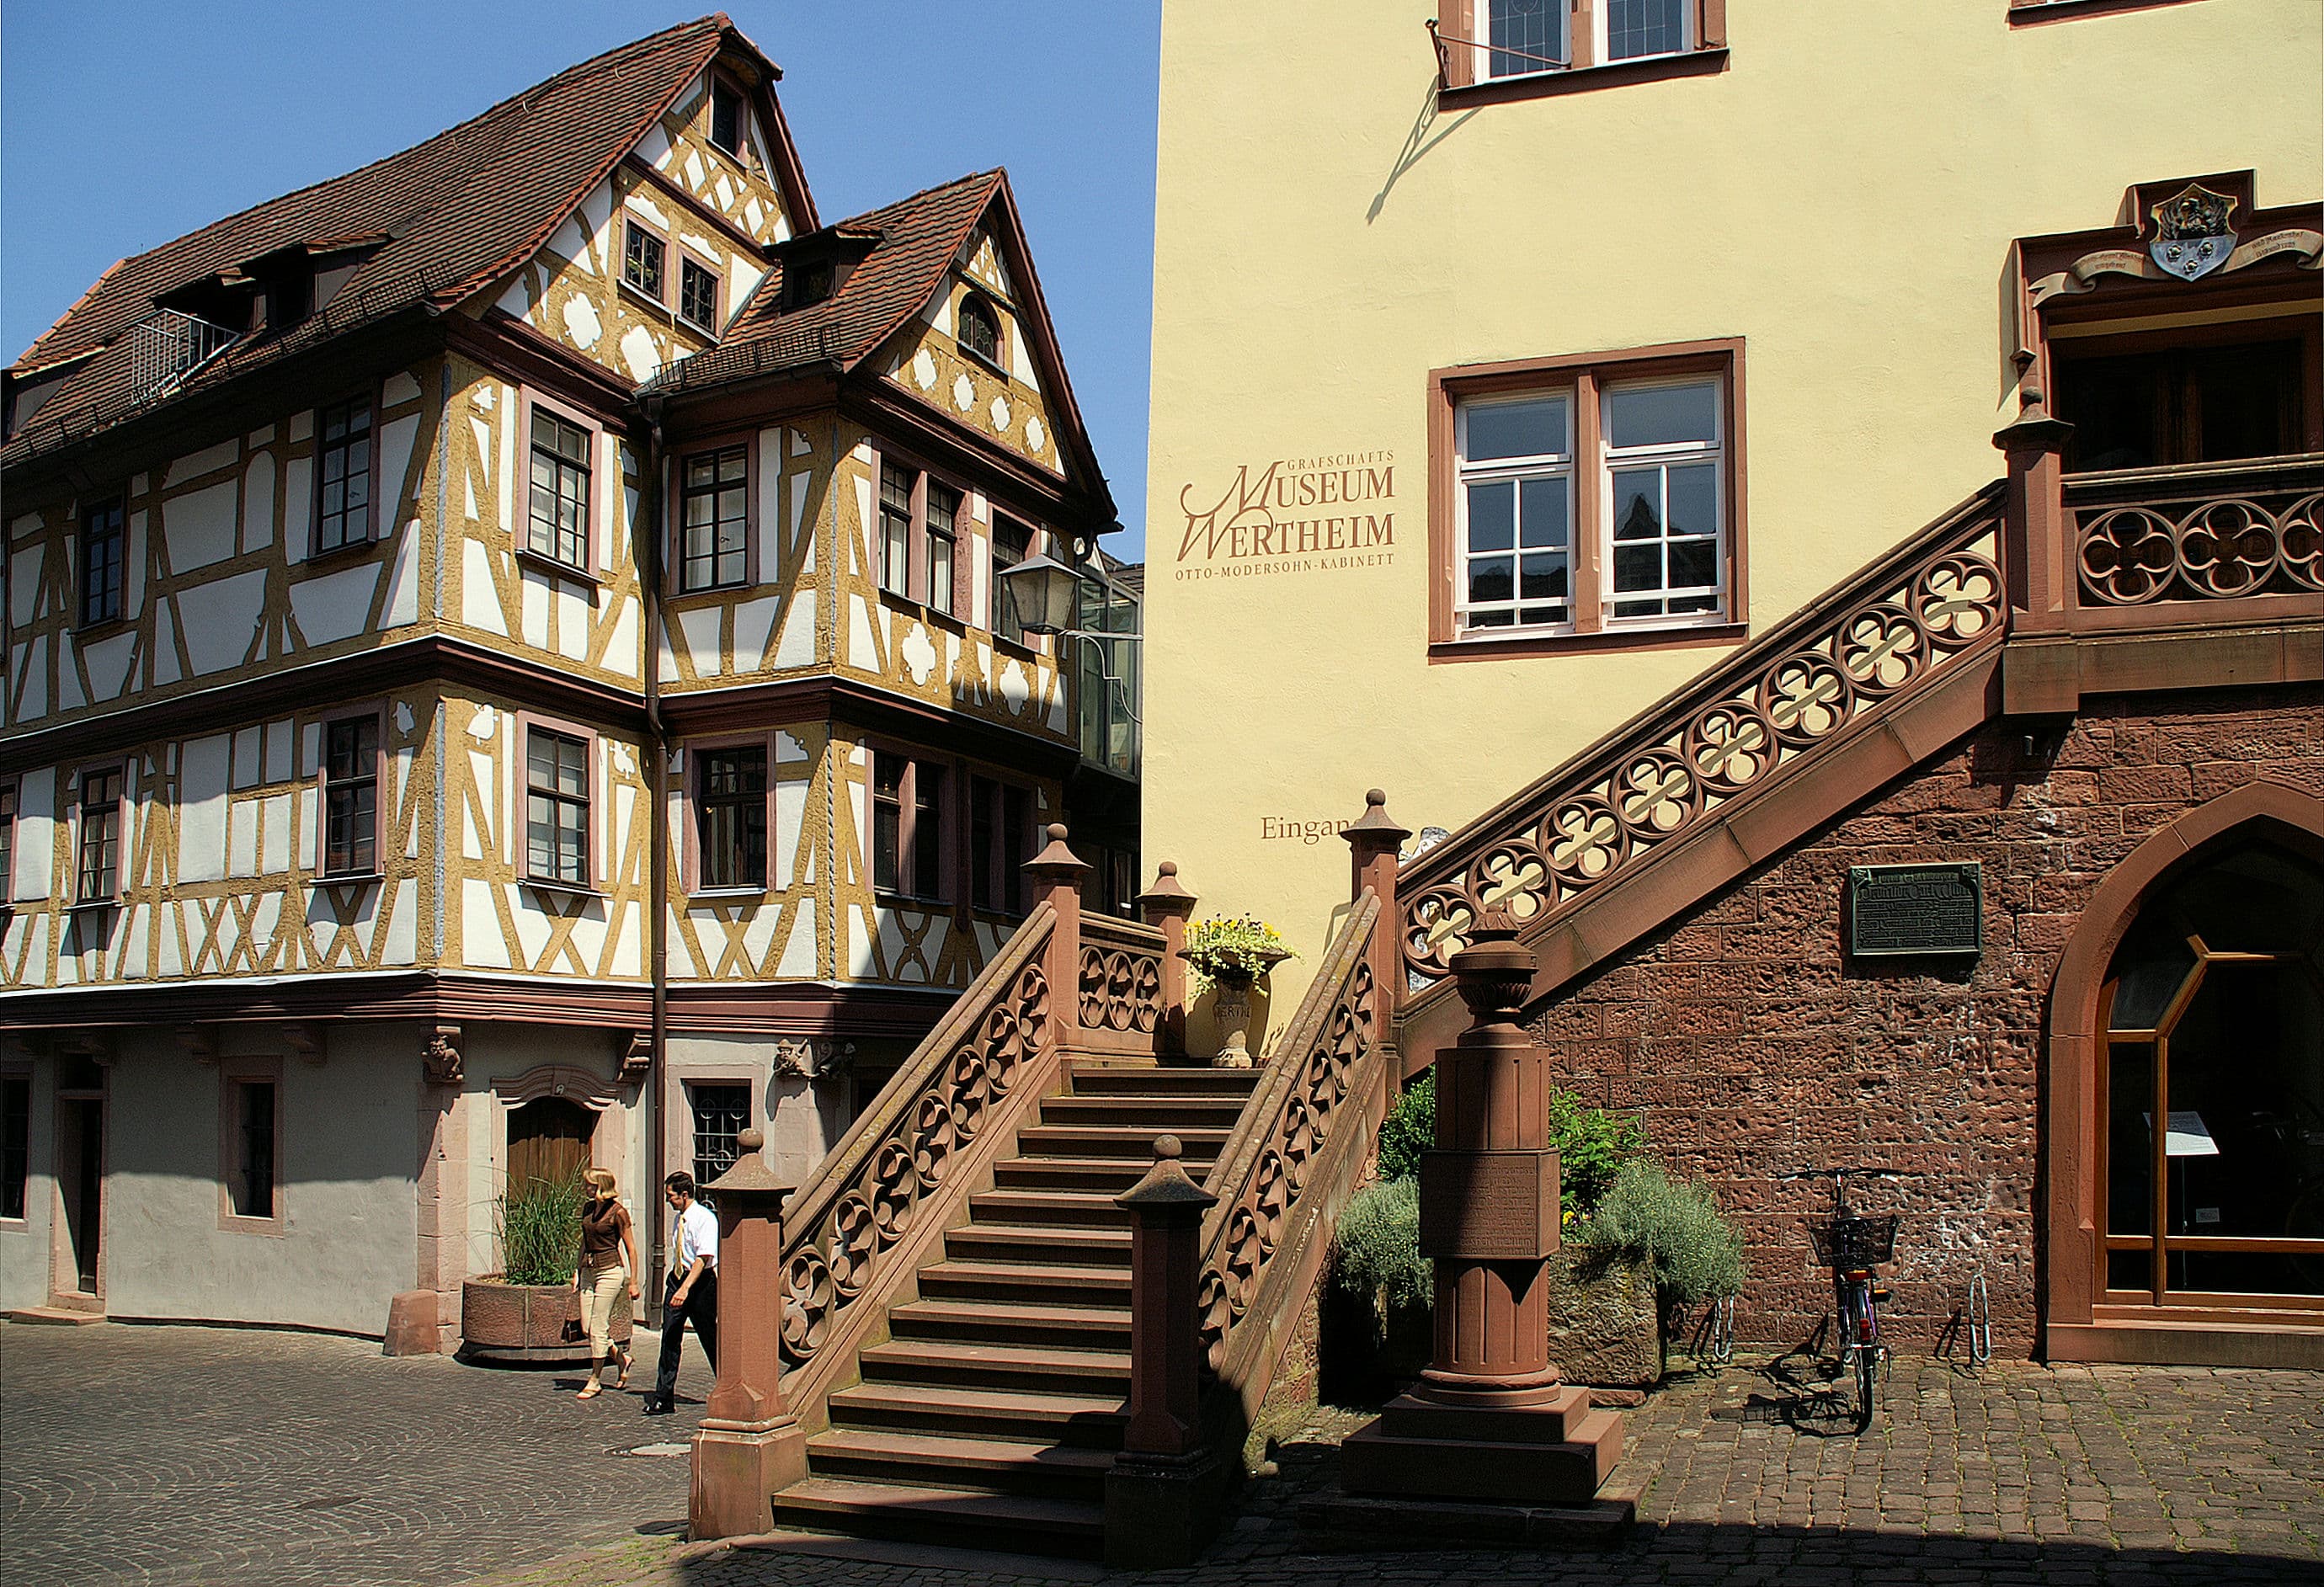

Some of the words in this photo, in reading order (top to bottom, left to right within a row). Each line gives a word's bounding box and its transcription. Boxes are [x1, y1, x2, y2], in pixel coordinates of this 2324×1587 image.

[1287, 450, 1394, 471] GRAFSCHAFTS
[1181, 461, 1395, 518] MUSEUM
[1176, 506, 1395, 562] WERTHEIM
[1175, 552, 1394, 581] OTTO-MODERSOHN-KABINETT
[1261, 817, 1361, 845] Eingan
